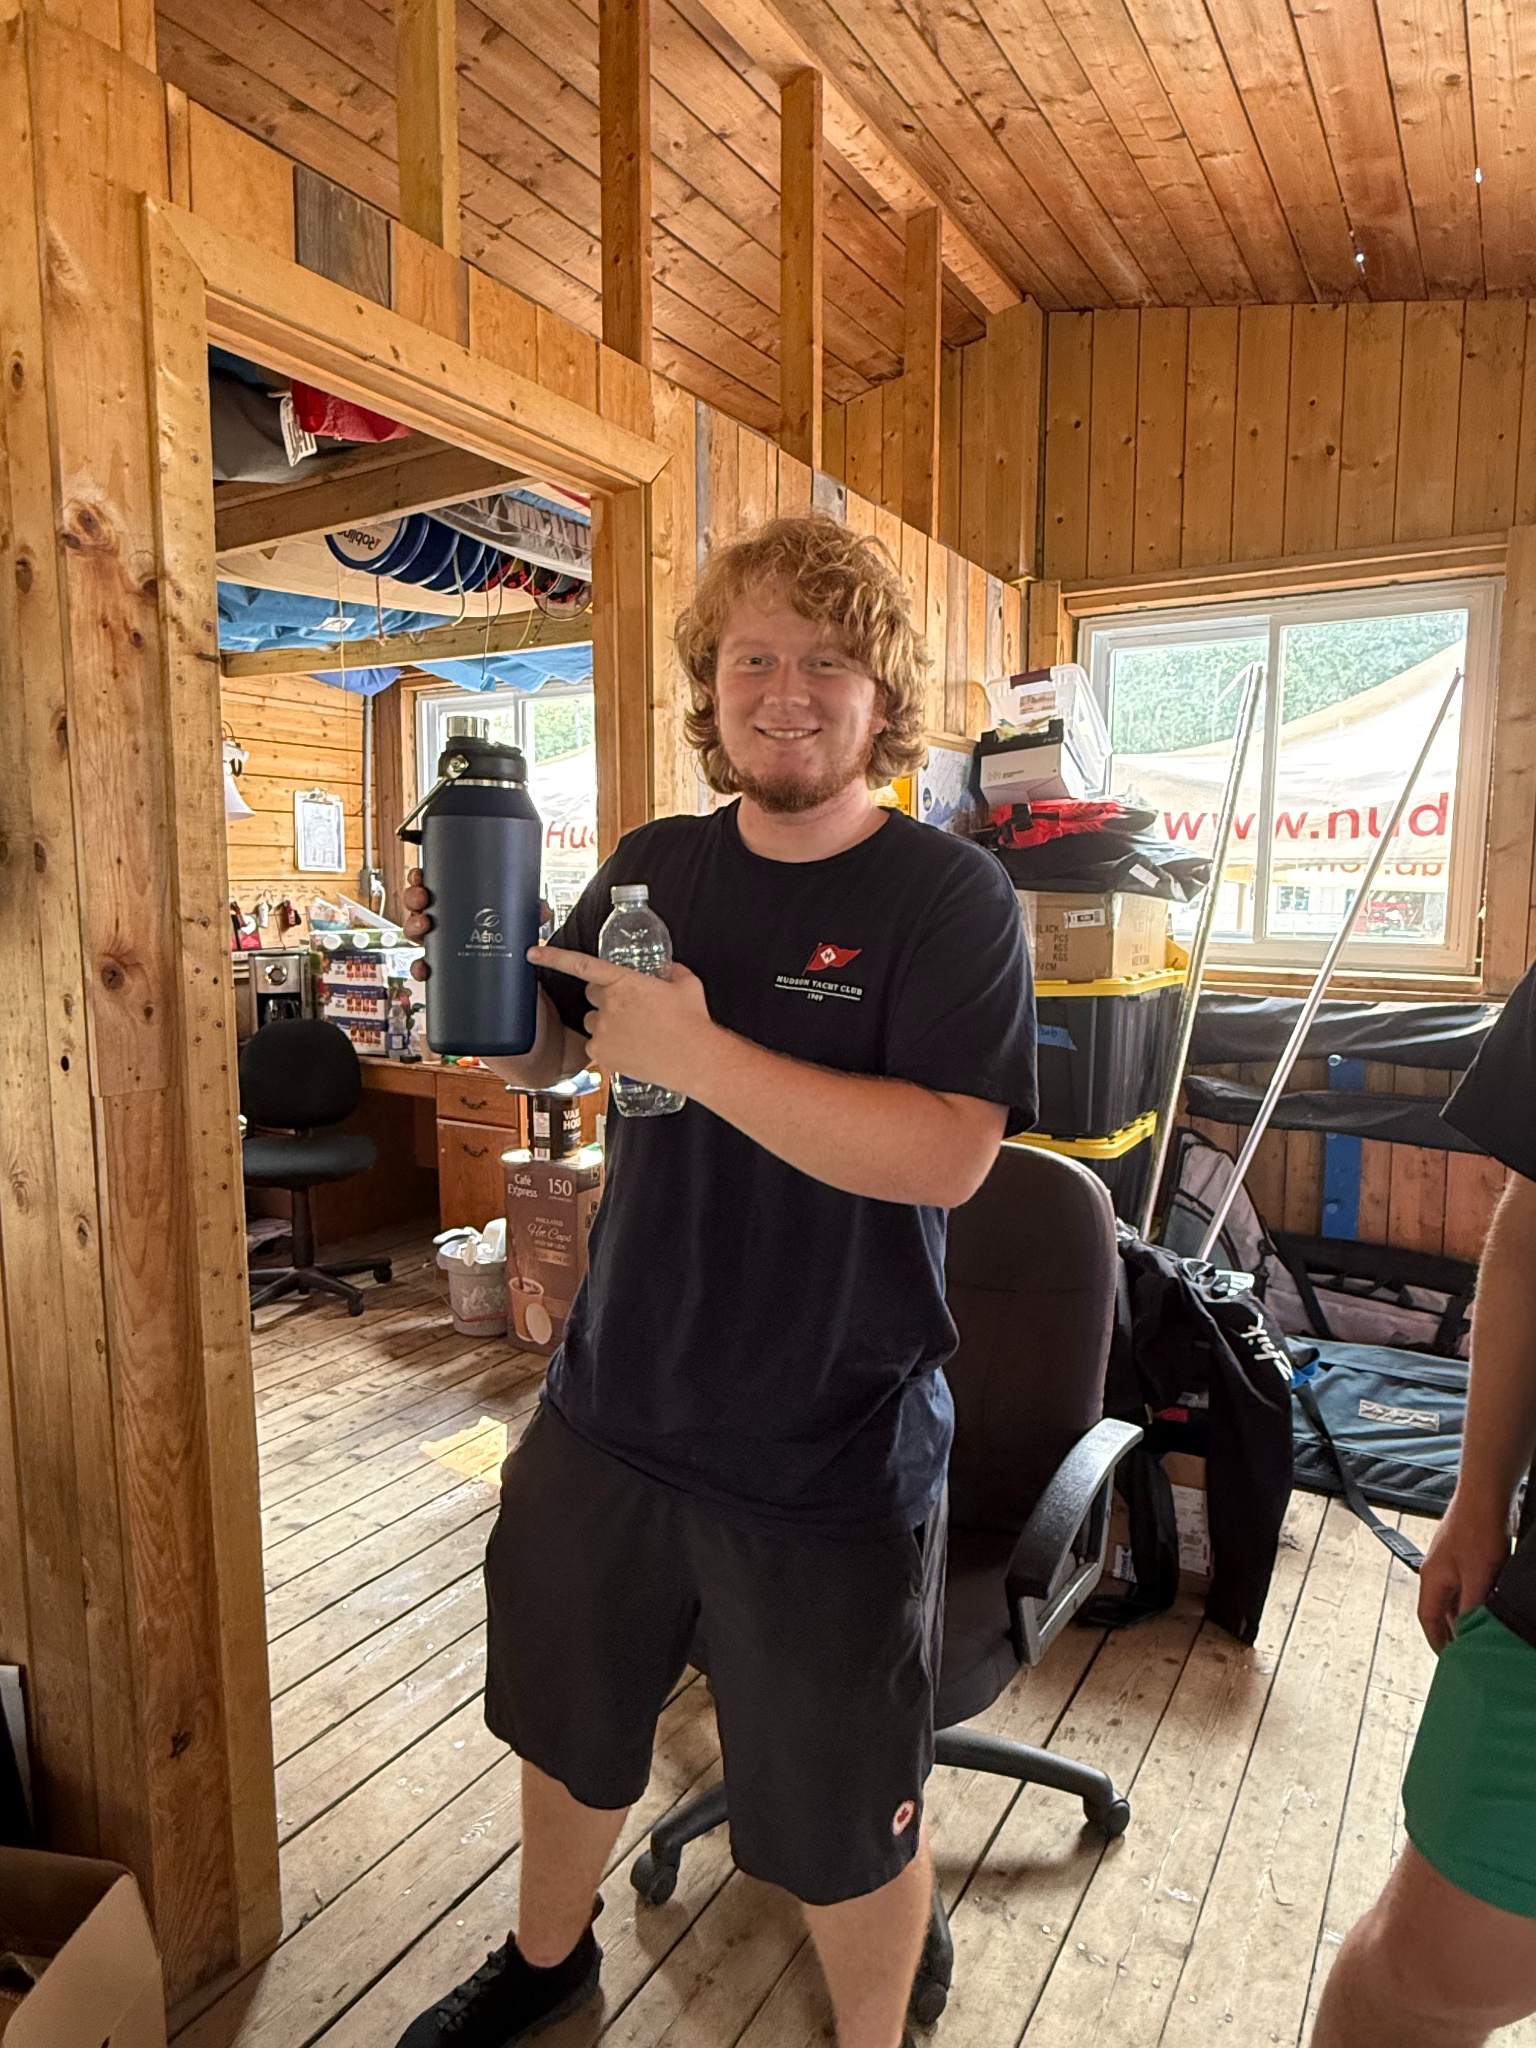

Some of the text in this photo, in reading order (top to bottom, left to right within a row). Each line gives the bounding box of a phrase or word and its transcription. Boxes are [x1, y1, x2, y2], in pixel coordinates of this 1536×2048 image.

[776, 975, 862, 996] HUDSON YACHT CLUB
[548, 1177, 573, 1197] 150
[1239, 1312, 1295, 1382] Zhik
